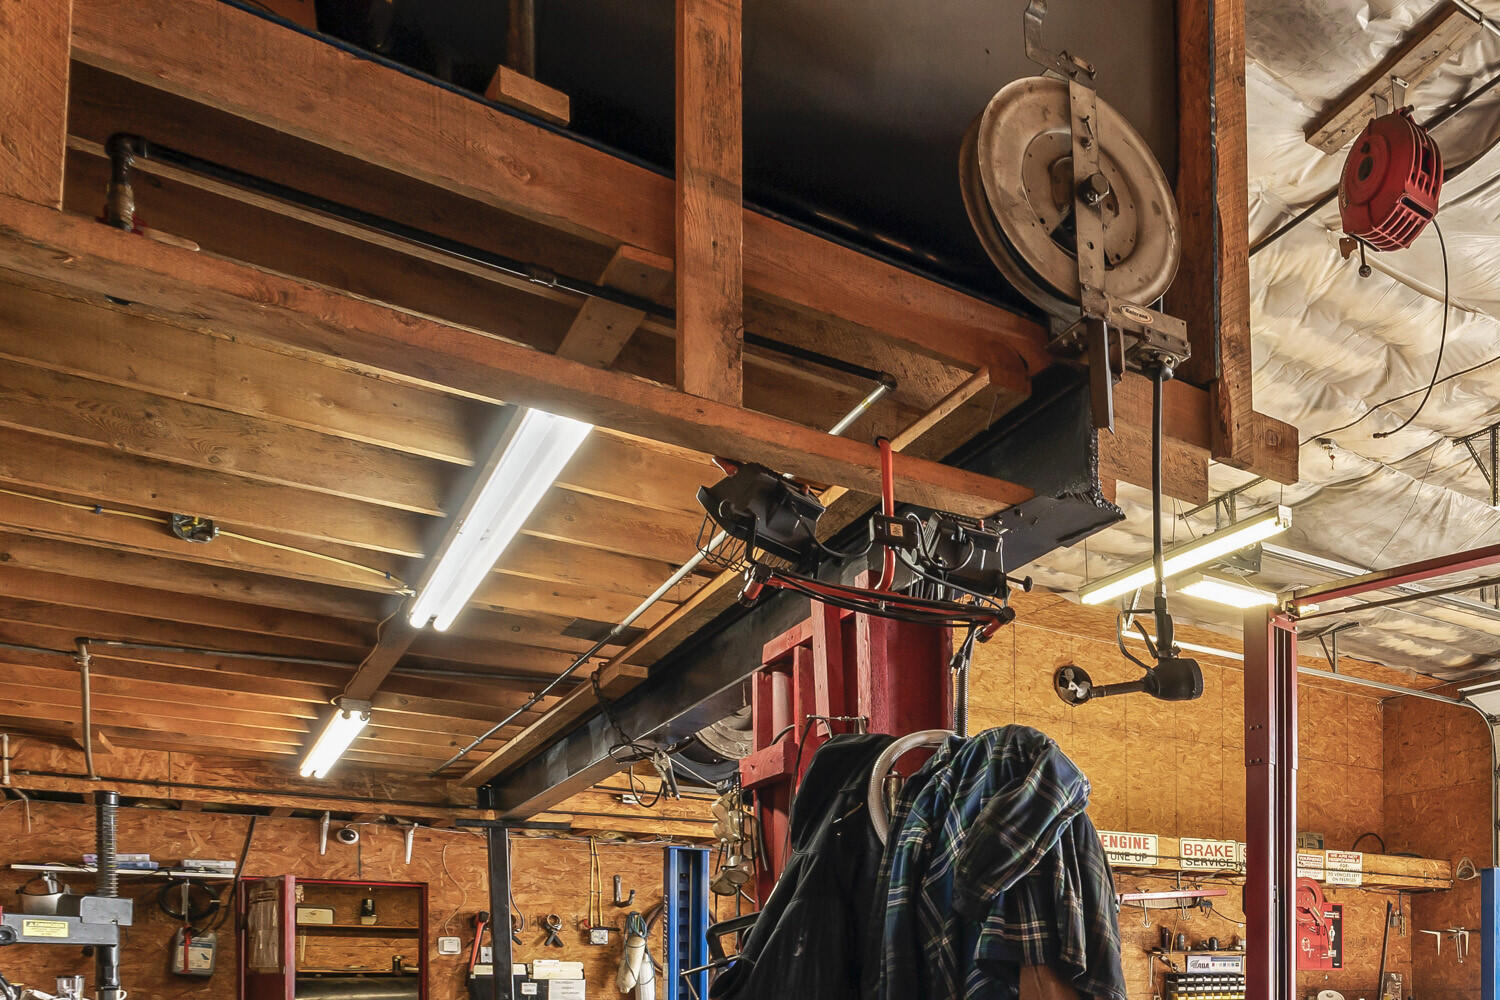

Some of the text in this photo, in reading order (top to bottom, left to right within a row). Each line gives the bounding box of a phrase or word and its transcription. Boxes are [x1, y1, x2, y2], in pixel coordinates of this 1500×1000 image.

[1100, 834, 1150, 850] ENGINE
[1183, 843, 1234, 858] BRAKE
[1185, 858, 1234, 868] SERVICE
